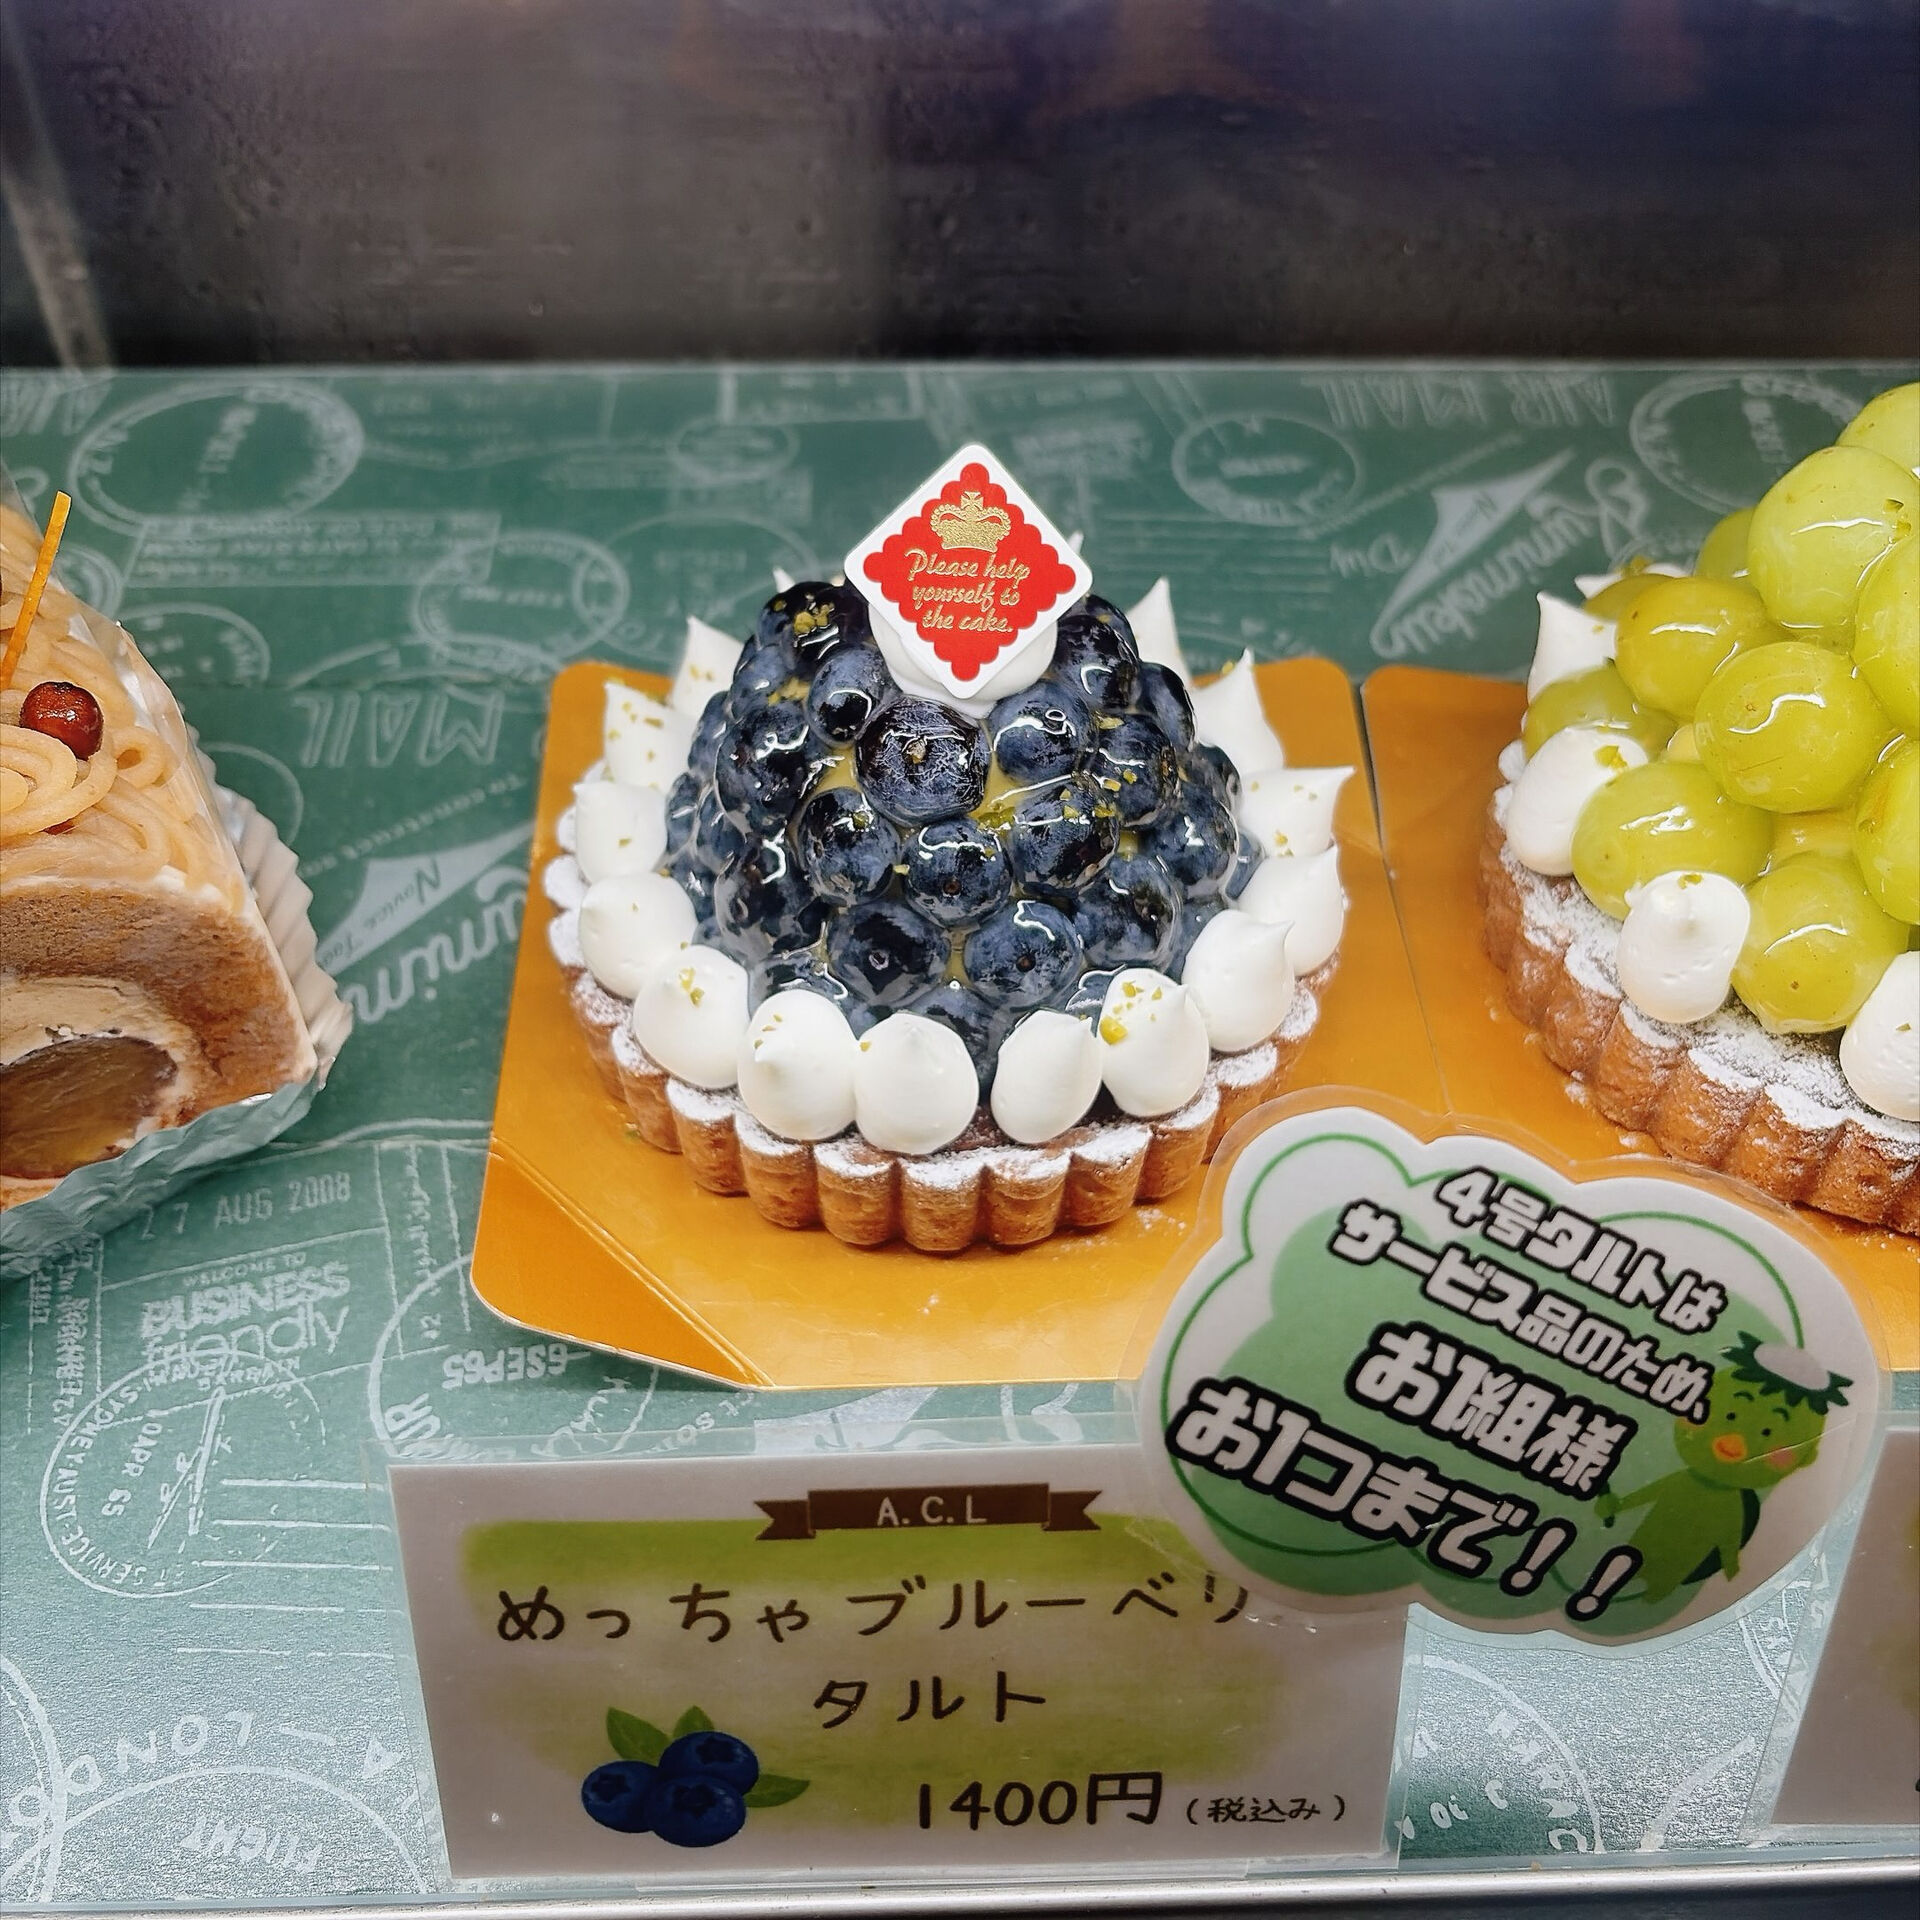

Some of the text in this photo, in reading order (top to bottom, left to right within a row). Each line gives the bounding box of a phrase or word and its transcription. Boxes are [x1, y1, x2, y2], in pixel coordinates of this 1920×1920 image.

[904, 548, 1031, 589] Please help
[912, 580, 1021, 613] yourself to
[921, 604, 1014, 632] the cake.
[214, 1187, 273, 1229] AUG
[288, 1171, 351, 1212] 2008
[1434, 1167, 1728, 1335] 4号タルトは
[1327, 1199, 1712, 1424] サービス品のため、
[1345, 1321, 1640, 1500] お1組様
[876, 1495, 989, 1527] A.C.L
[813, 1670, 1047, 1730] タルト
[918, 1770, 1165, 1832] 1400円
[1186, 1795, 1347, 1827] (税込み)
